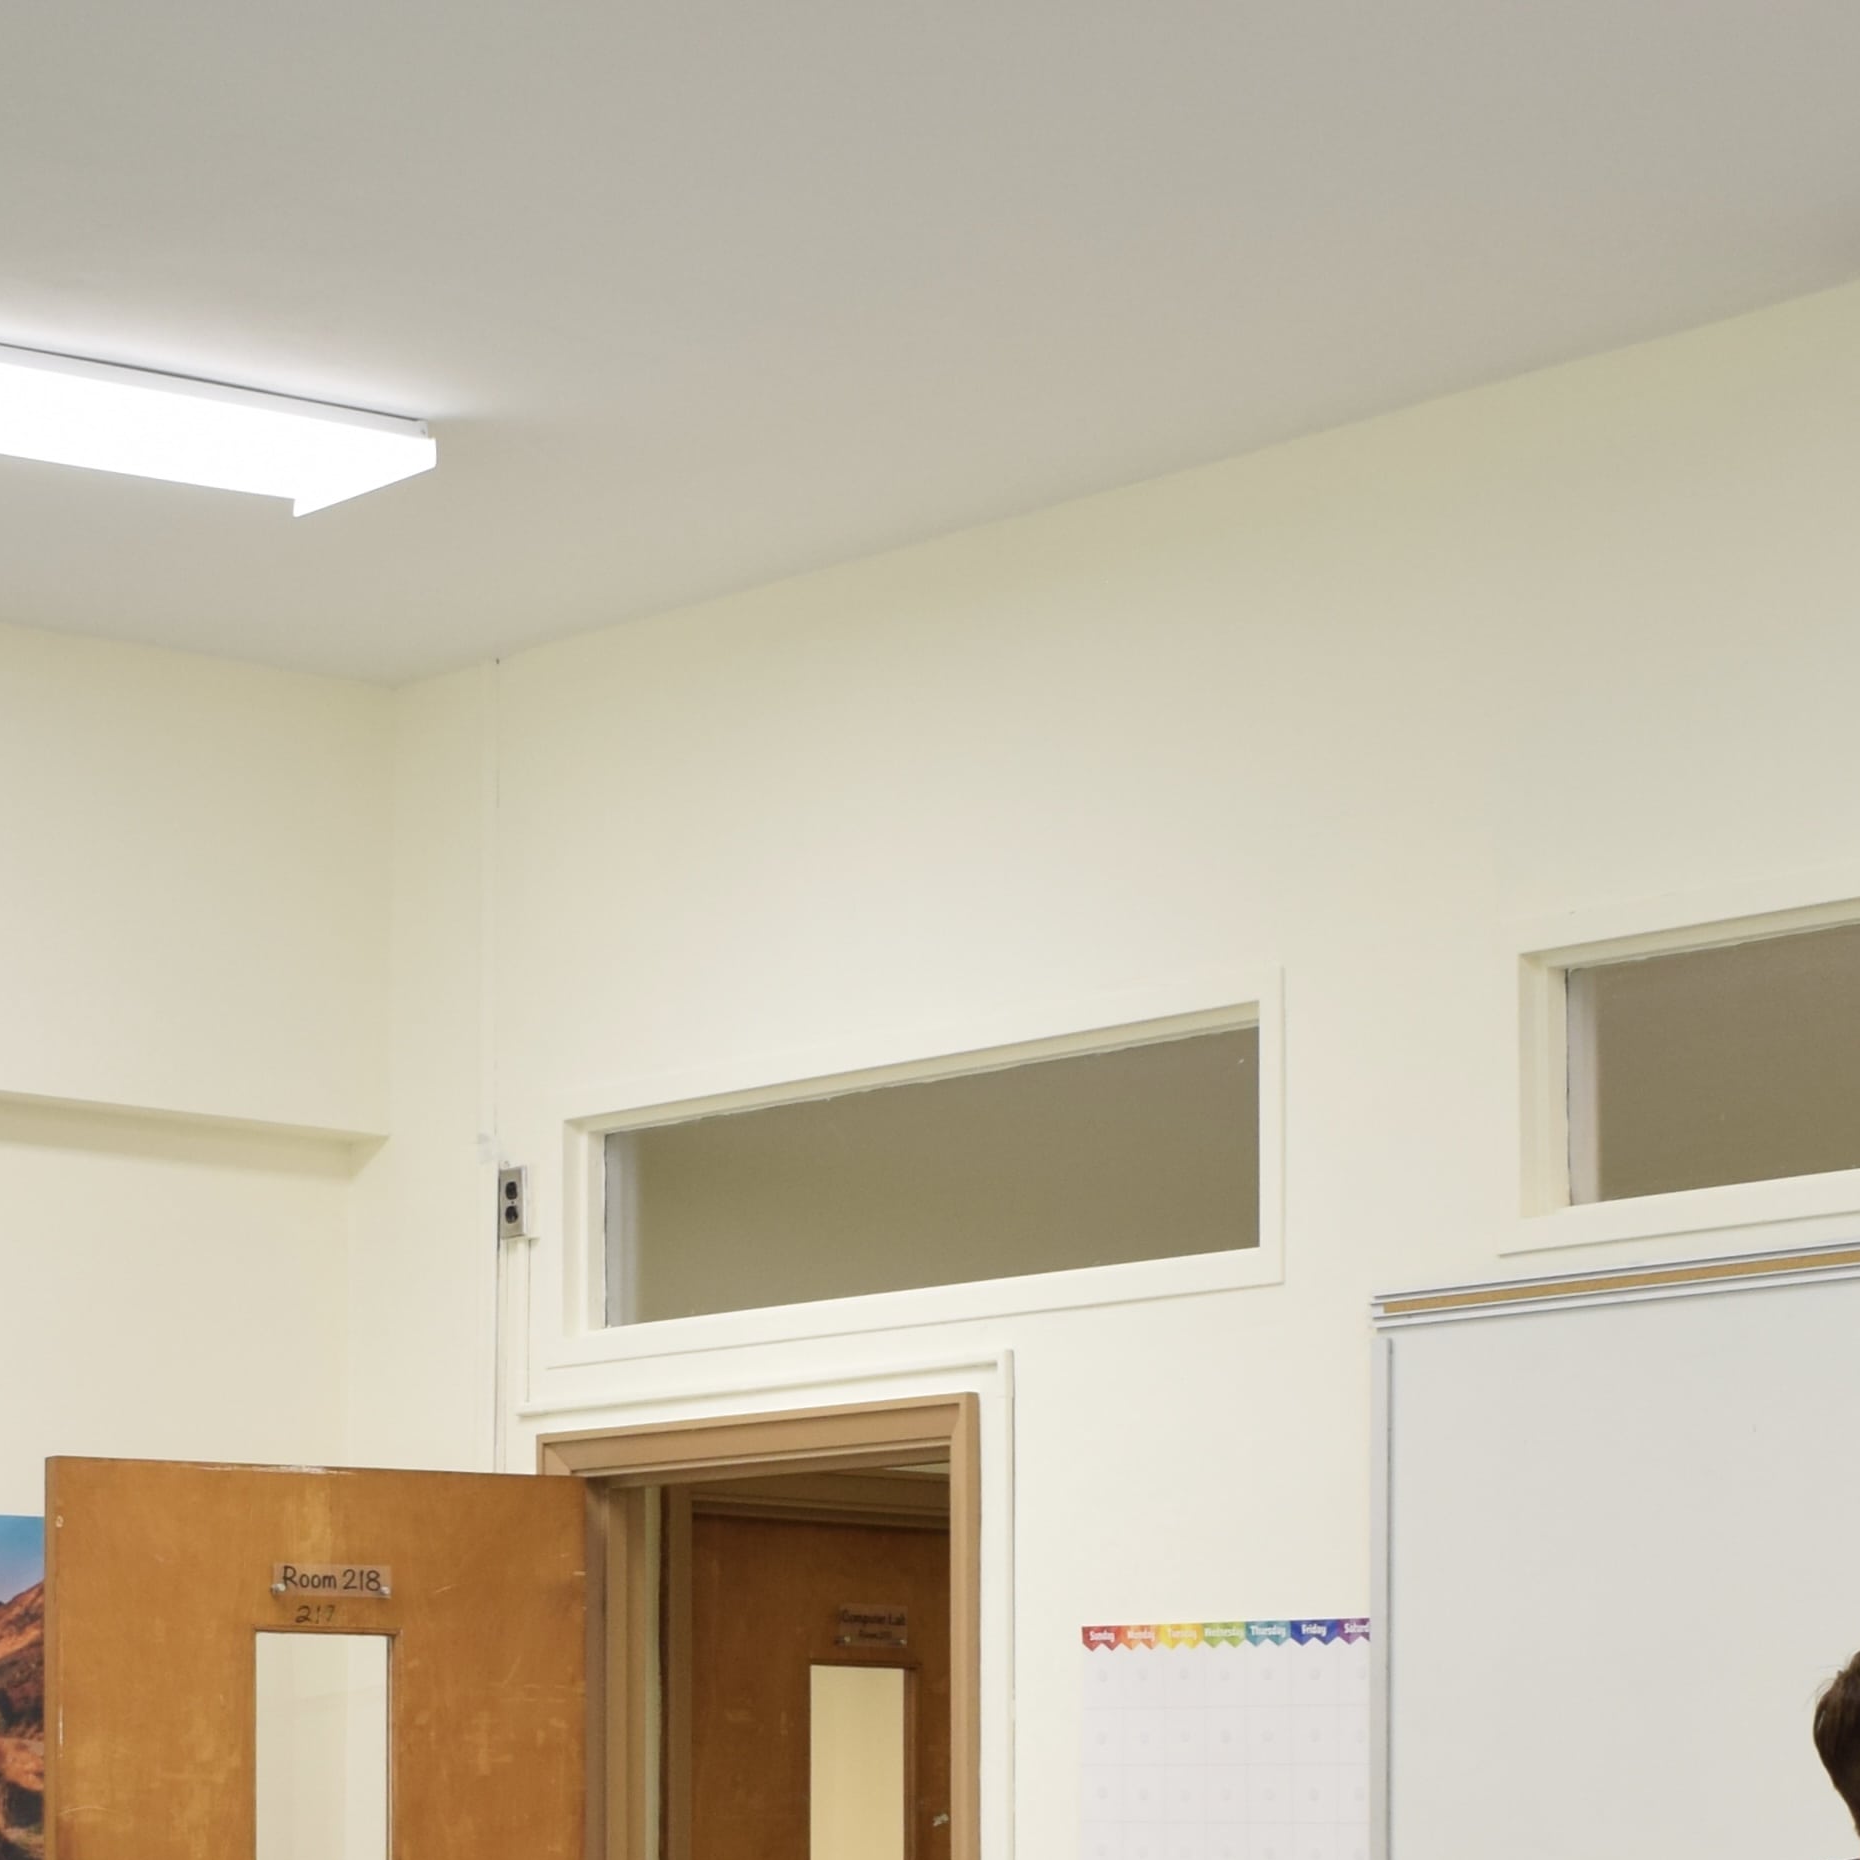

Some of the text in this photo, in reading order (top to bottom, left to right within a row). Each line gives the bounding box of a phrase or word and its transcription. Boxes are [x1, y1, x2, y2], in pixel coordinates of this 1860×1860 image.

[283, 1565, 380, 1591] Room 218
[1090, 1630, 1115, 1643] Sunday
[1250, 1625, 1286, 1638] Thursday
[1302, 1624, 1327, 1637] Friday
